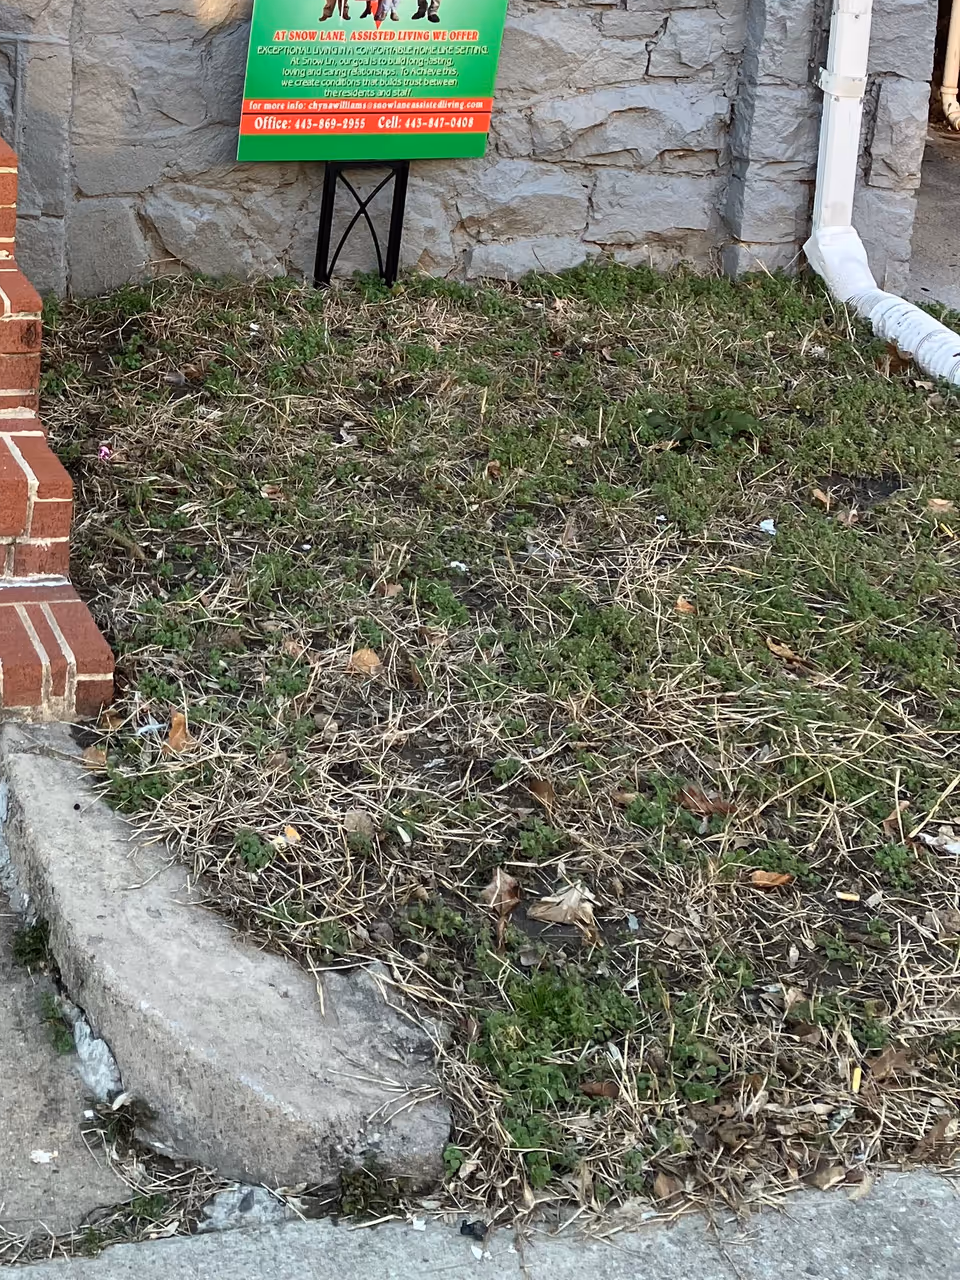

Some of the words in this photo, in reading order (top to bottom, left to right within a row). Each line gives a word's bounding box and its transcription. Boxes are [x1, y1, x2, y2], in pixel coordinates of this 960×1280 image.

[273, 30, 286, 41] AT
[288, 30, 317, 41] SNOW
[320, 30, 346, 41] LANE,
[350, 30, 396, 41] ASSISTED
[397, 30, 430, 41] LIVING
[432, 30, 448, 41] WE
[449, 30, 479, 41] OFFER
[257, 46, 312, 55] EXCEPTIONAL
[312, 46, 339, 55] LIVING
[355, 46, 413, 55] COMFORTABLE
[413, 46, 437, 55] HOME
[437, 46, 454, 55] LIKE
[290, 57, 301, 66] At
[302, 57, 324, 66] Snow
[340, 57, 352, 66] our
[352, 57, 370, 66] goal
[378, 57, 387, 66] to
[388, 57, 406, 66] build
[282, 67, 306, 77] loving
[307, 67, 322, 77] and
[323, 67, 348, 77] caring
[400, 67, 409, 77] To
[410, 67, 442, 77] Achieve
[281, 79, 294, 87] we
[294, 79, 320, 87] create
[320, 79, 361, 87] conditions
[362, 79, 378, 87] that
[380, 79, 402, 87] builds
[403, 79, 423, 87] trust
[423, 79, 458, 87] between
[323, 89, 339, 98] the
[339, 89, 376, 98] residents
[376, 89, 391, 98] and
[249, 101, 261, 111] for
[263, 101, 285, 111] more
[286, 101, 306, 111] info:
[254, 116, 292, 129] Office:
[294, 118, 366, 129] 443-869-2955
[377, 116, 402, 128] Cell:
[405, 117, 475, 128] 443-847-0408
